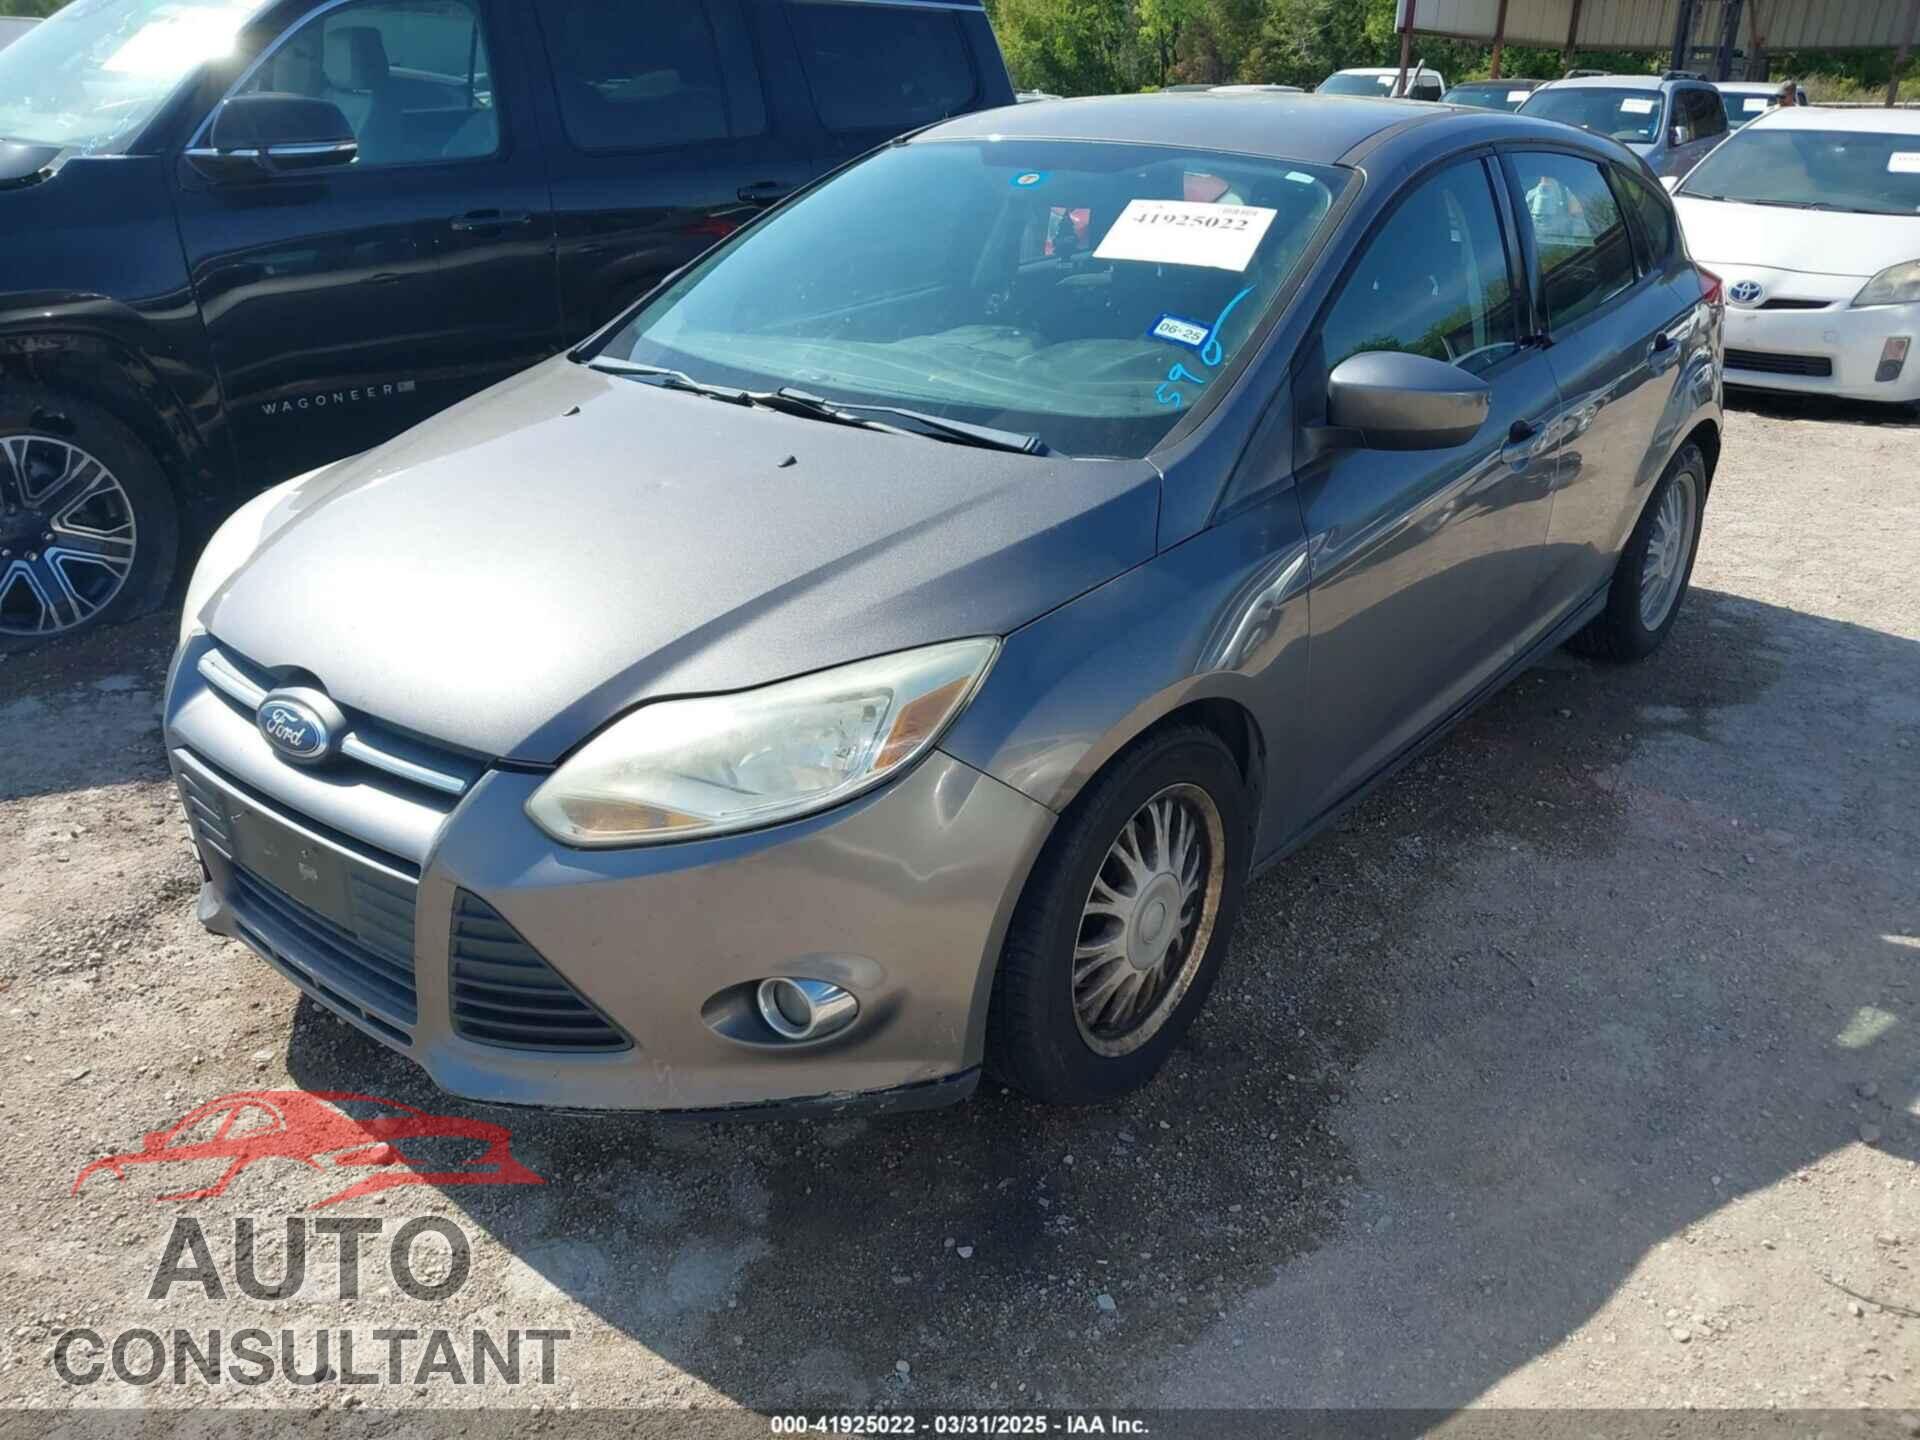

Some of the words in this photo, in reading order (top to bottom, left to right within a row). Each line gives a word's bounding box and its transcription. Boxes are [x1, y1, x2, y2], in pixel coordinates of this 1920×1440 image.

[1133, 213, 1248, 230] 41925022
[261, 384, 392, 415] WAGONEER
[266, 709, 306, 746] Ford
